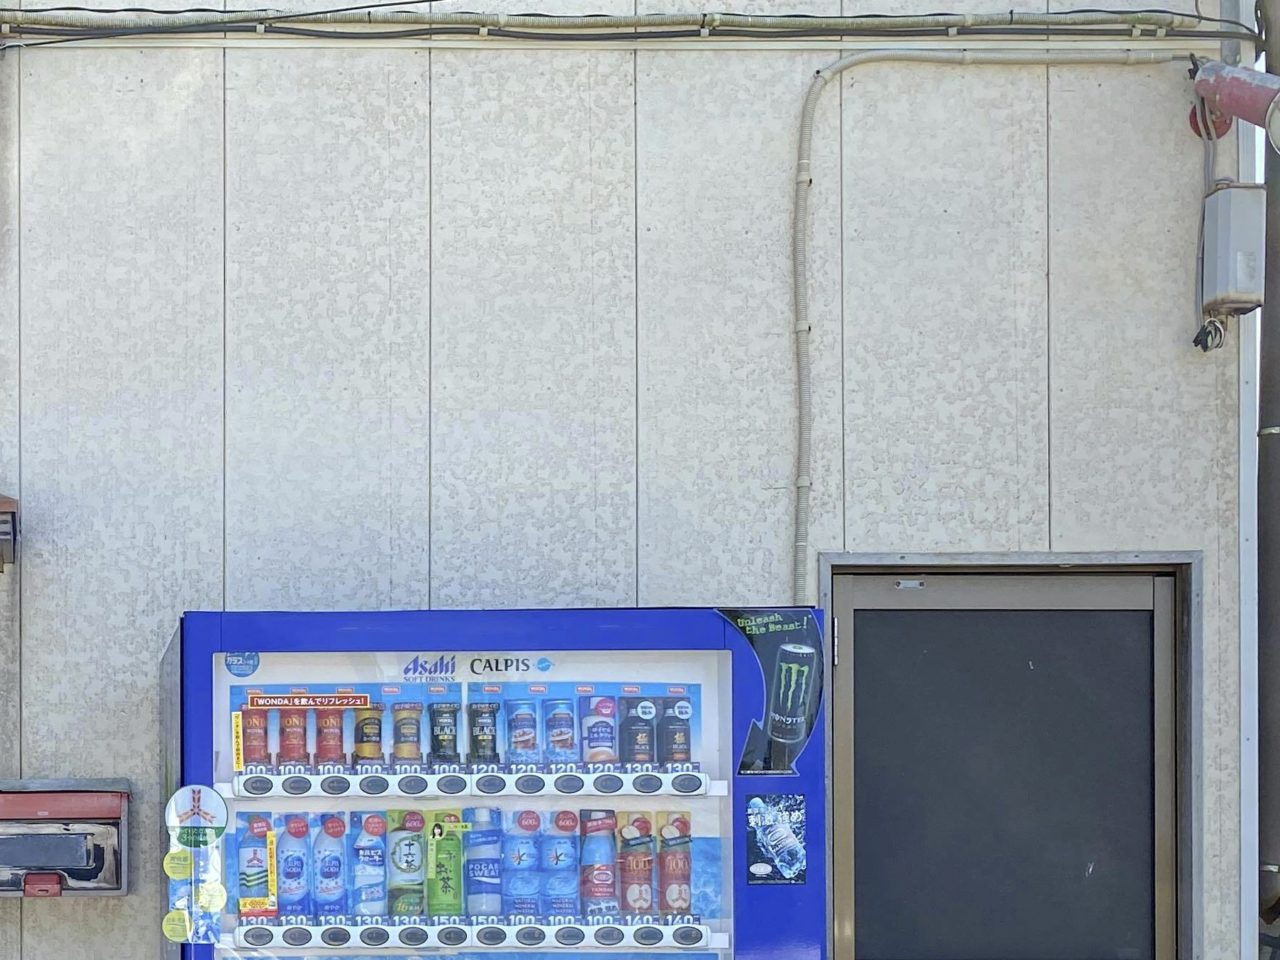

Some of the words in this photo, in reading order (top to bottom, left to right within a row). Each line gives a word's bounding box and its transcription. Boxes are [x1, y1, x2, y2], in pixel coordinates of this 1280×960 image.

[737, 613, 783, 627] Unleash
[746, 624, 766, 635] the
[769, 617, 808, 633] Beast!
[404, 655, 456, 675] Asahi
[470, 658, 530, 674] CALPIS
